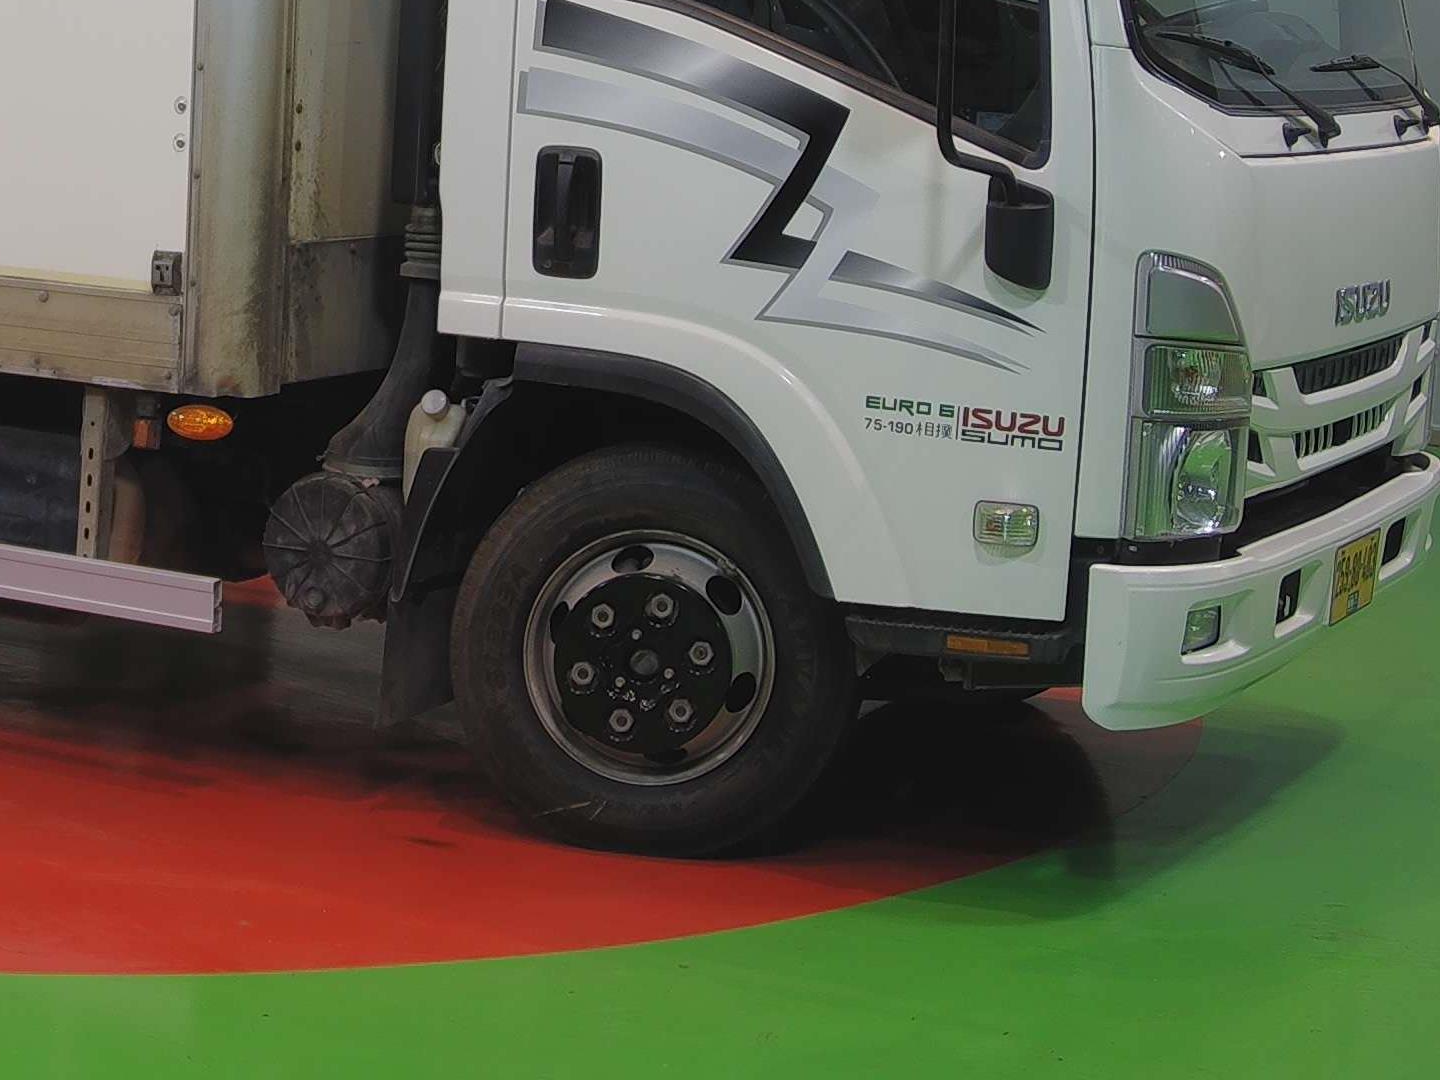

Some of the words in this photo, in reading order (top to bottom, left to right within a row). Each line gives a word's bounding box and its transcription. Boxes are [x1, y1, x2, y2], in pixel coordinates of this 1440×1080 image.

[1334, 279, 1391, 326] ISUZU
[865, 395, 932, 417] EURO
[938, 404, 955, 419] 6
[864, 418, 914, 436] 75-190
[962, 407, 1066, 437] ISUZU
[960, 429, 1064, 451] SUMO
